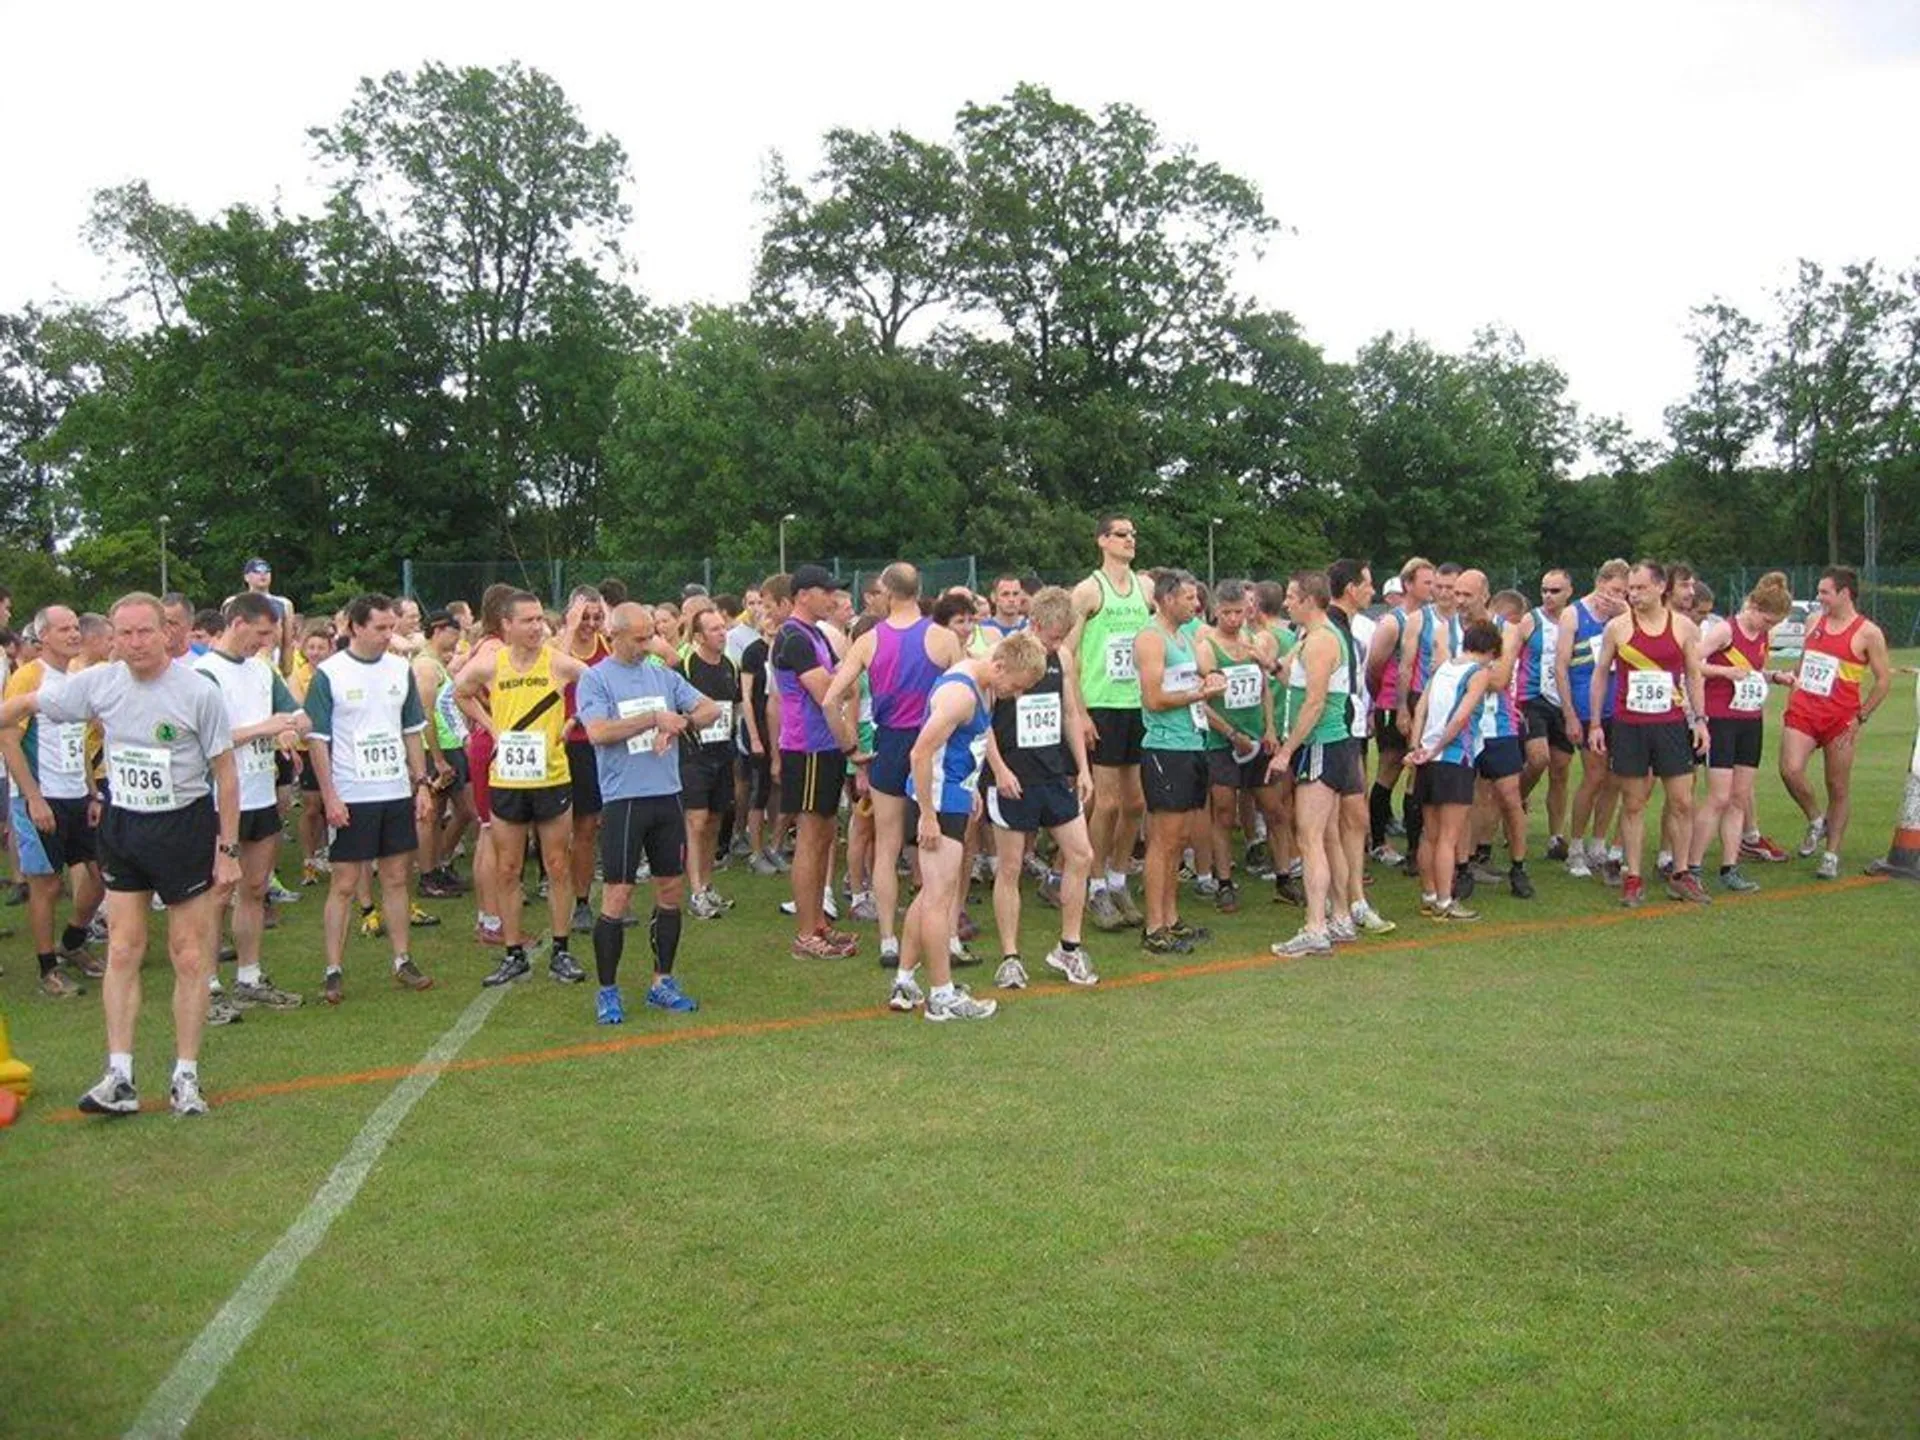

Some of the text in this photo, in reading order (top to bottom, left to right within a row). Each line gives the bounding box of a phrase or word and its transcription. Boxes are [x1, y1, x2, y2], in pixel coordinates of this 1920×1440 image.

[1805, 664, 1830, 680] 1027
[499, 678, 549, 690] BEDFORD
[1231, 678, 1256, 696] 577
[1636, 684, 1665, 700] 586
[1026, 711, 1057, 728] 1042
[363, 746, 397, 763] 1013
[506, 747, 536, 766] 634
[119, 767, 163, 790] 1036
